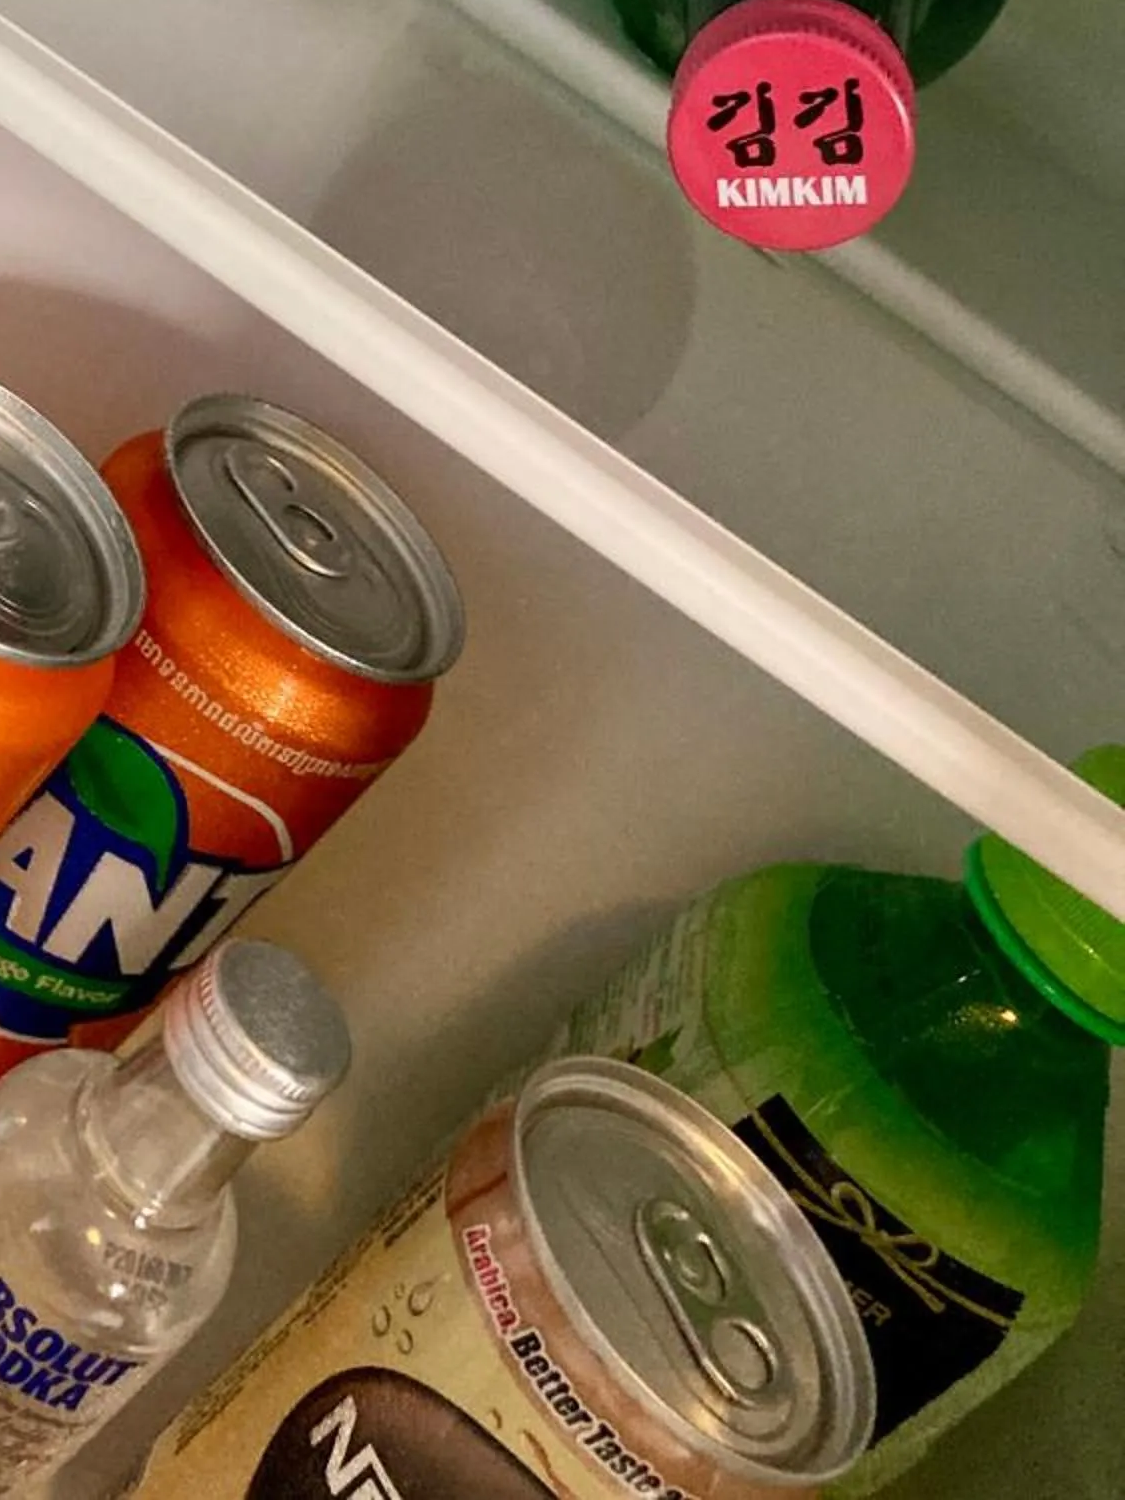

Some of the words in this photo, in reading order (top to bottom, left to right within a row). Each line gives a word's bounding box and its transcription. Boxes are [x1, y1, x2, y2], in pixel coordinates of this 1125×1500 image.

[717, 173, 868, 208] KIMKIM
[35, 974, 123, 1004] Flavor
[511, 1331, 593, 1428] Better
[584, 1423, 662, 1494] Taste
